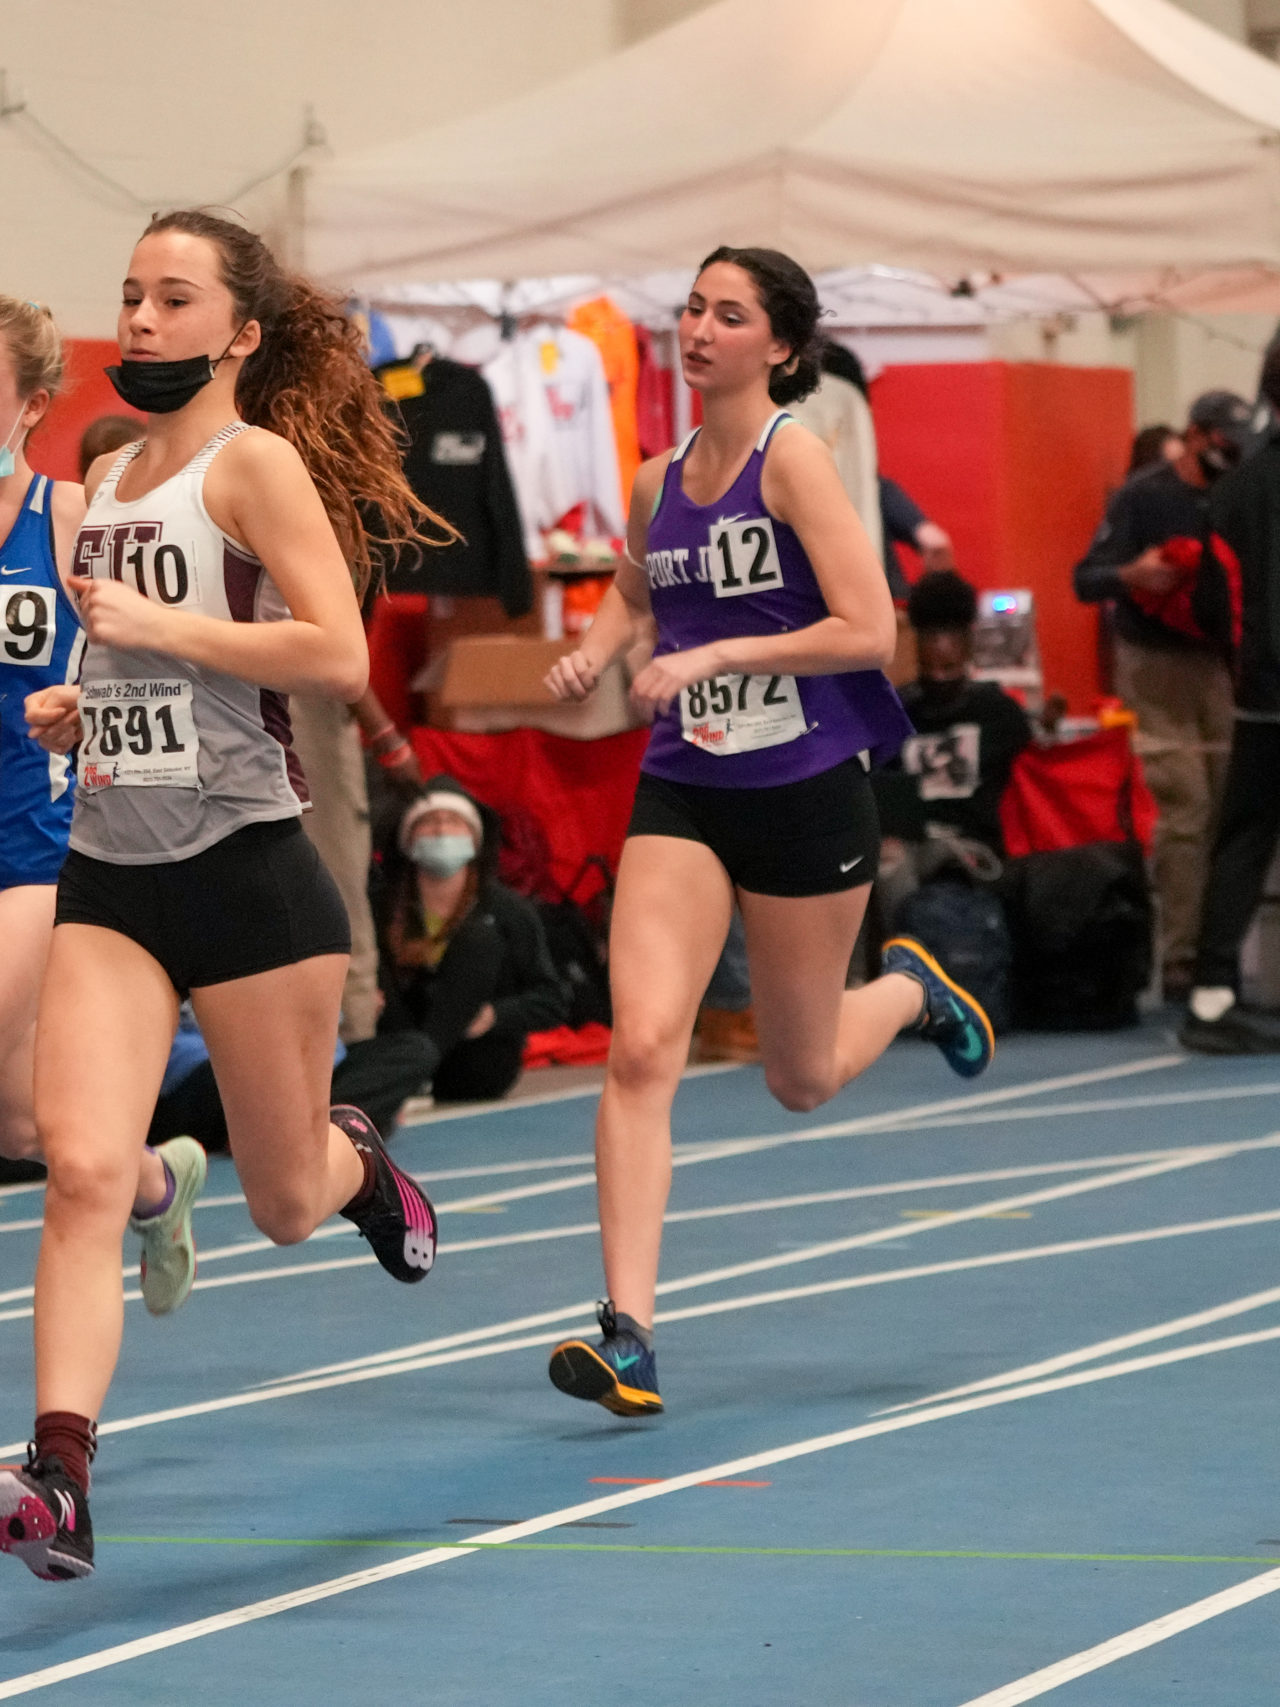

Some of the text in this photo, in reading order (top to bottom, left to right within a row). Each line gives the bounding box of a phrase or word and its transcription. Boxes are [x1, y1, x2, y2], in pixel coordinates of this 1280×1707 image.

[127, 544, 188, 604] 10
[646, 548, 691, 589] PORT
[717, 527, 777, 588] 12
[4, 591, 48, 660] 9
[123, 683, 146, 698] 2nd
[149, 683, 181, 697] Wind
[687, 675, 788, 719] 8572
[83, 704, 185, 756] 7691
